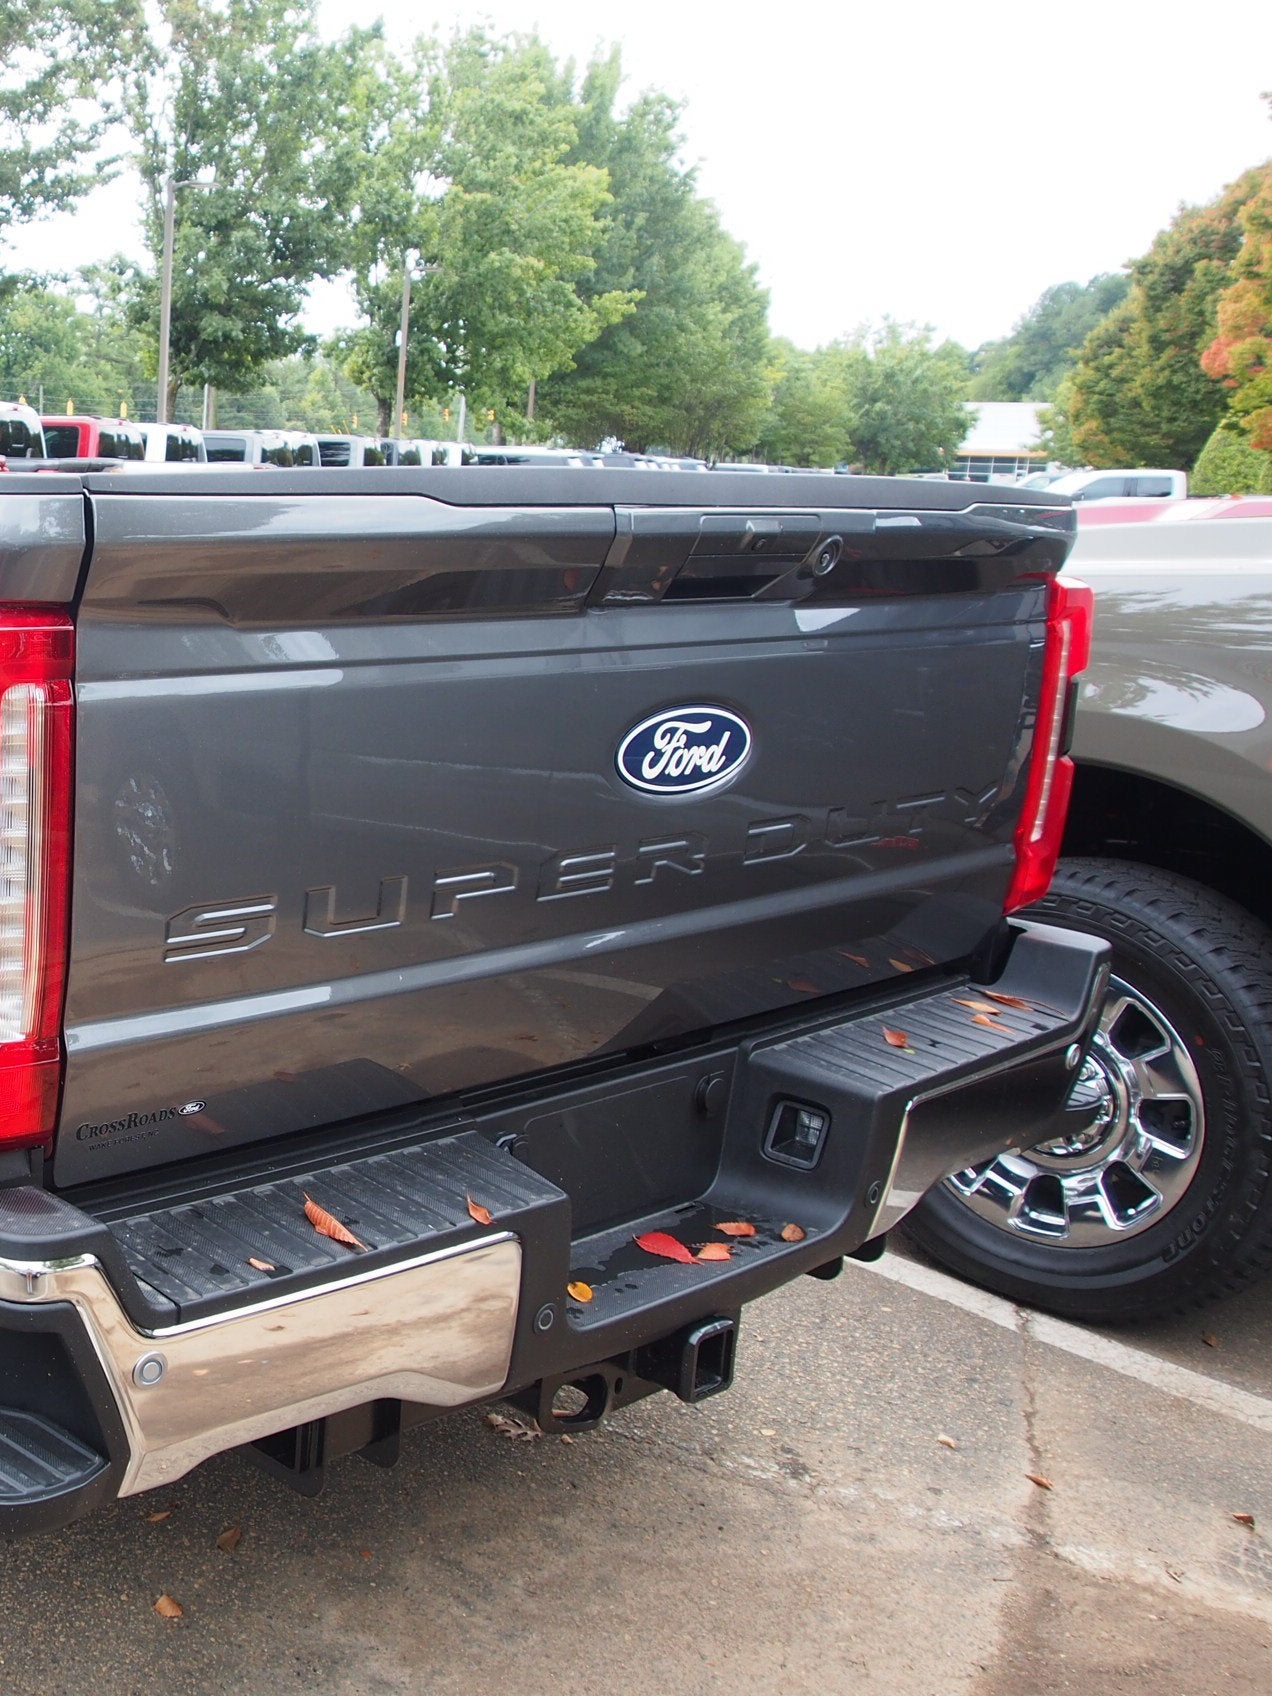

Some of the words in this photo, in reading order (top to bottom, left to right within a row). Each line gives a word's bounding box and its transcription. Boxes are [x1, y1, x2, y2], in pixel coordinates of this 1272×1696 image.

[640, 719, 732, 781] Ford
[162, 830, 708, 963] SUPER
[743, 781, 998, 866] DUTY
